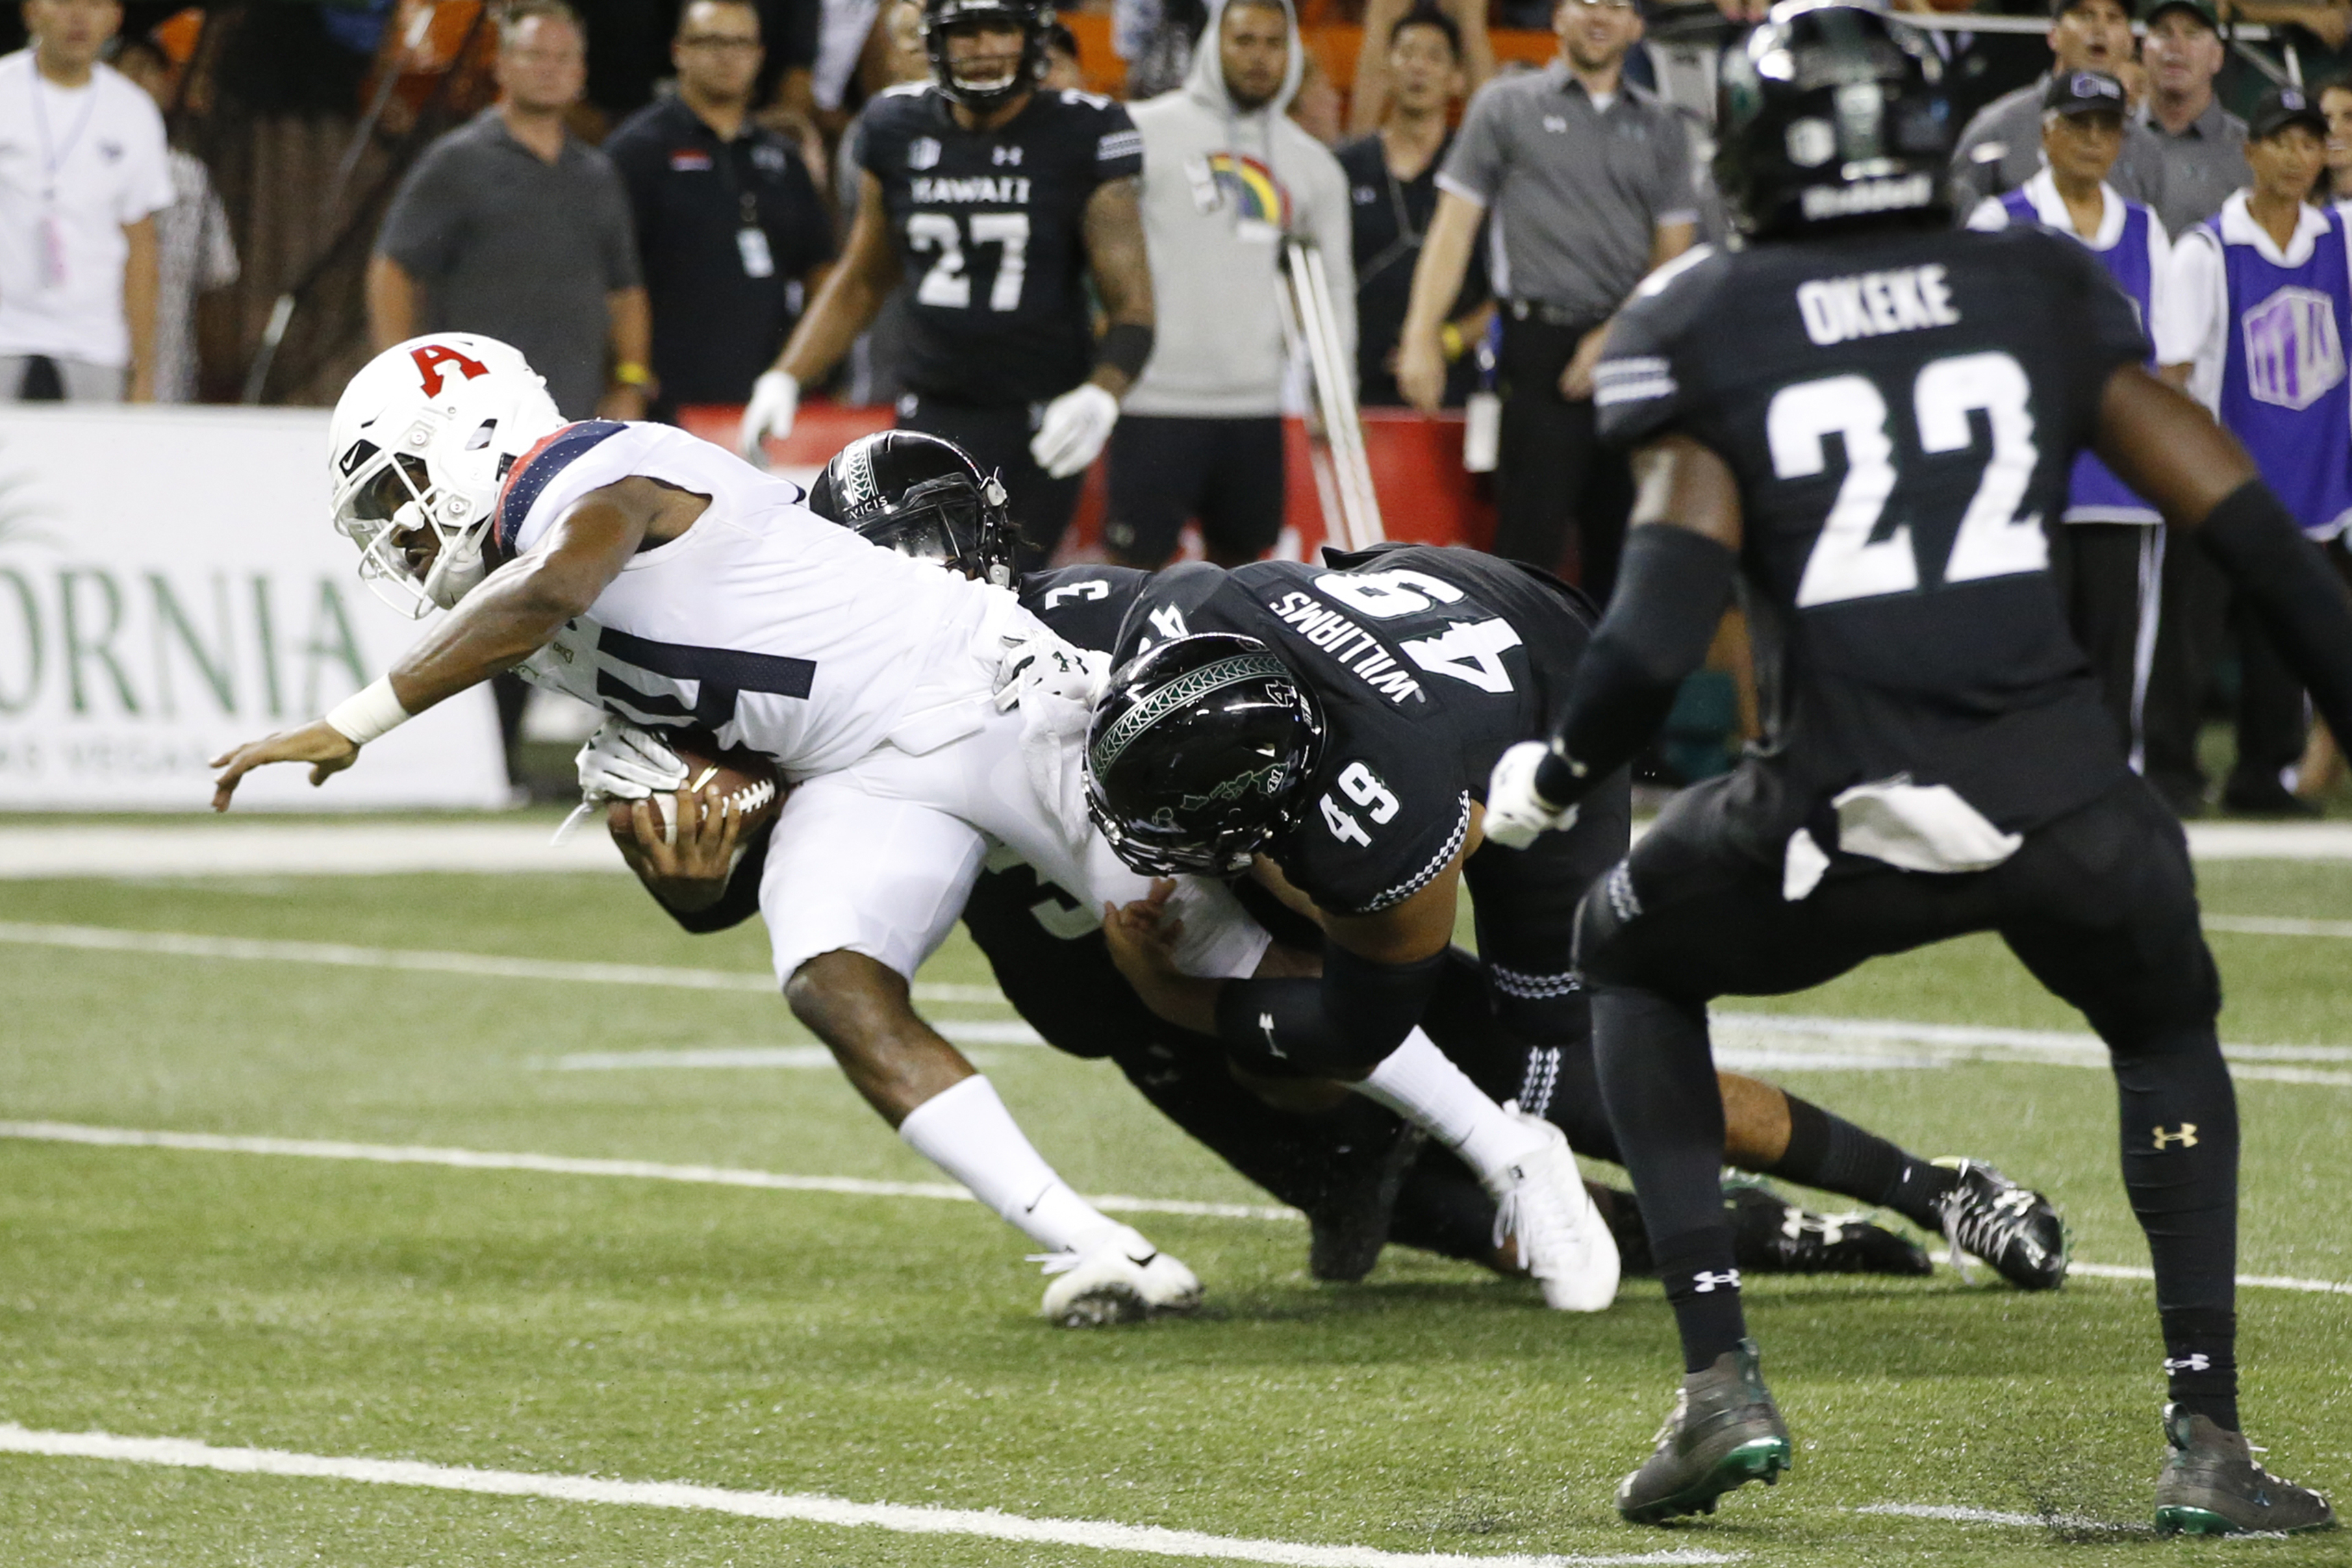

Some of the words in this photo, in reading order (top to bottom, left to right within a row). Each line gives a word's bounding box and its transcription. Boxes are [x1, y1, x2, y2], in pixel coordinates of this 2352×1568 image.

[907, 212, 1031, 312] 27
[1797, 263, 1962, 346] OKEKE
[409, 344, 490, 400] A
[849, 494, 889, 520] VICIS
[1766, 351, 2050, 608] 22
[1045, 578, 1109, 611] 3
[1137, 602, 1190, 656] 4
[1314, 568, 1527, 695] 49
[1268, 590, 1426, 704] WILLIAMS
[1318, 761, 1402, 849] 49
